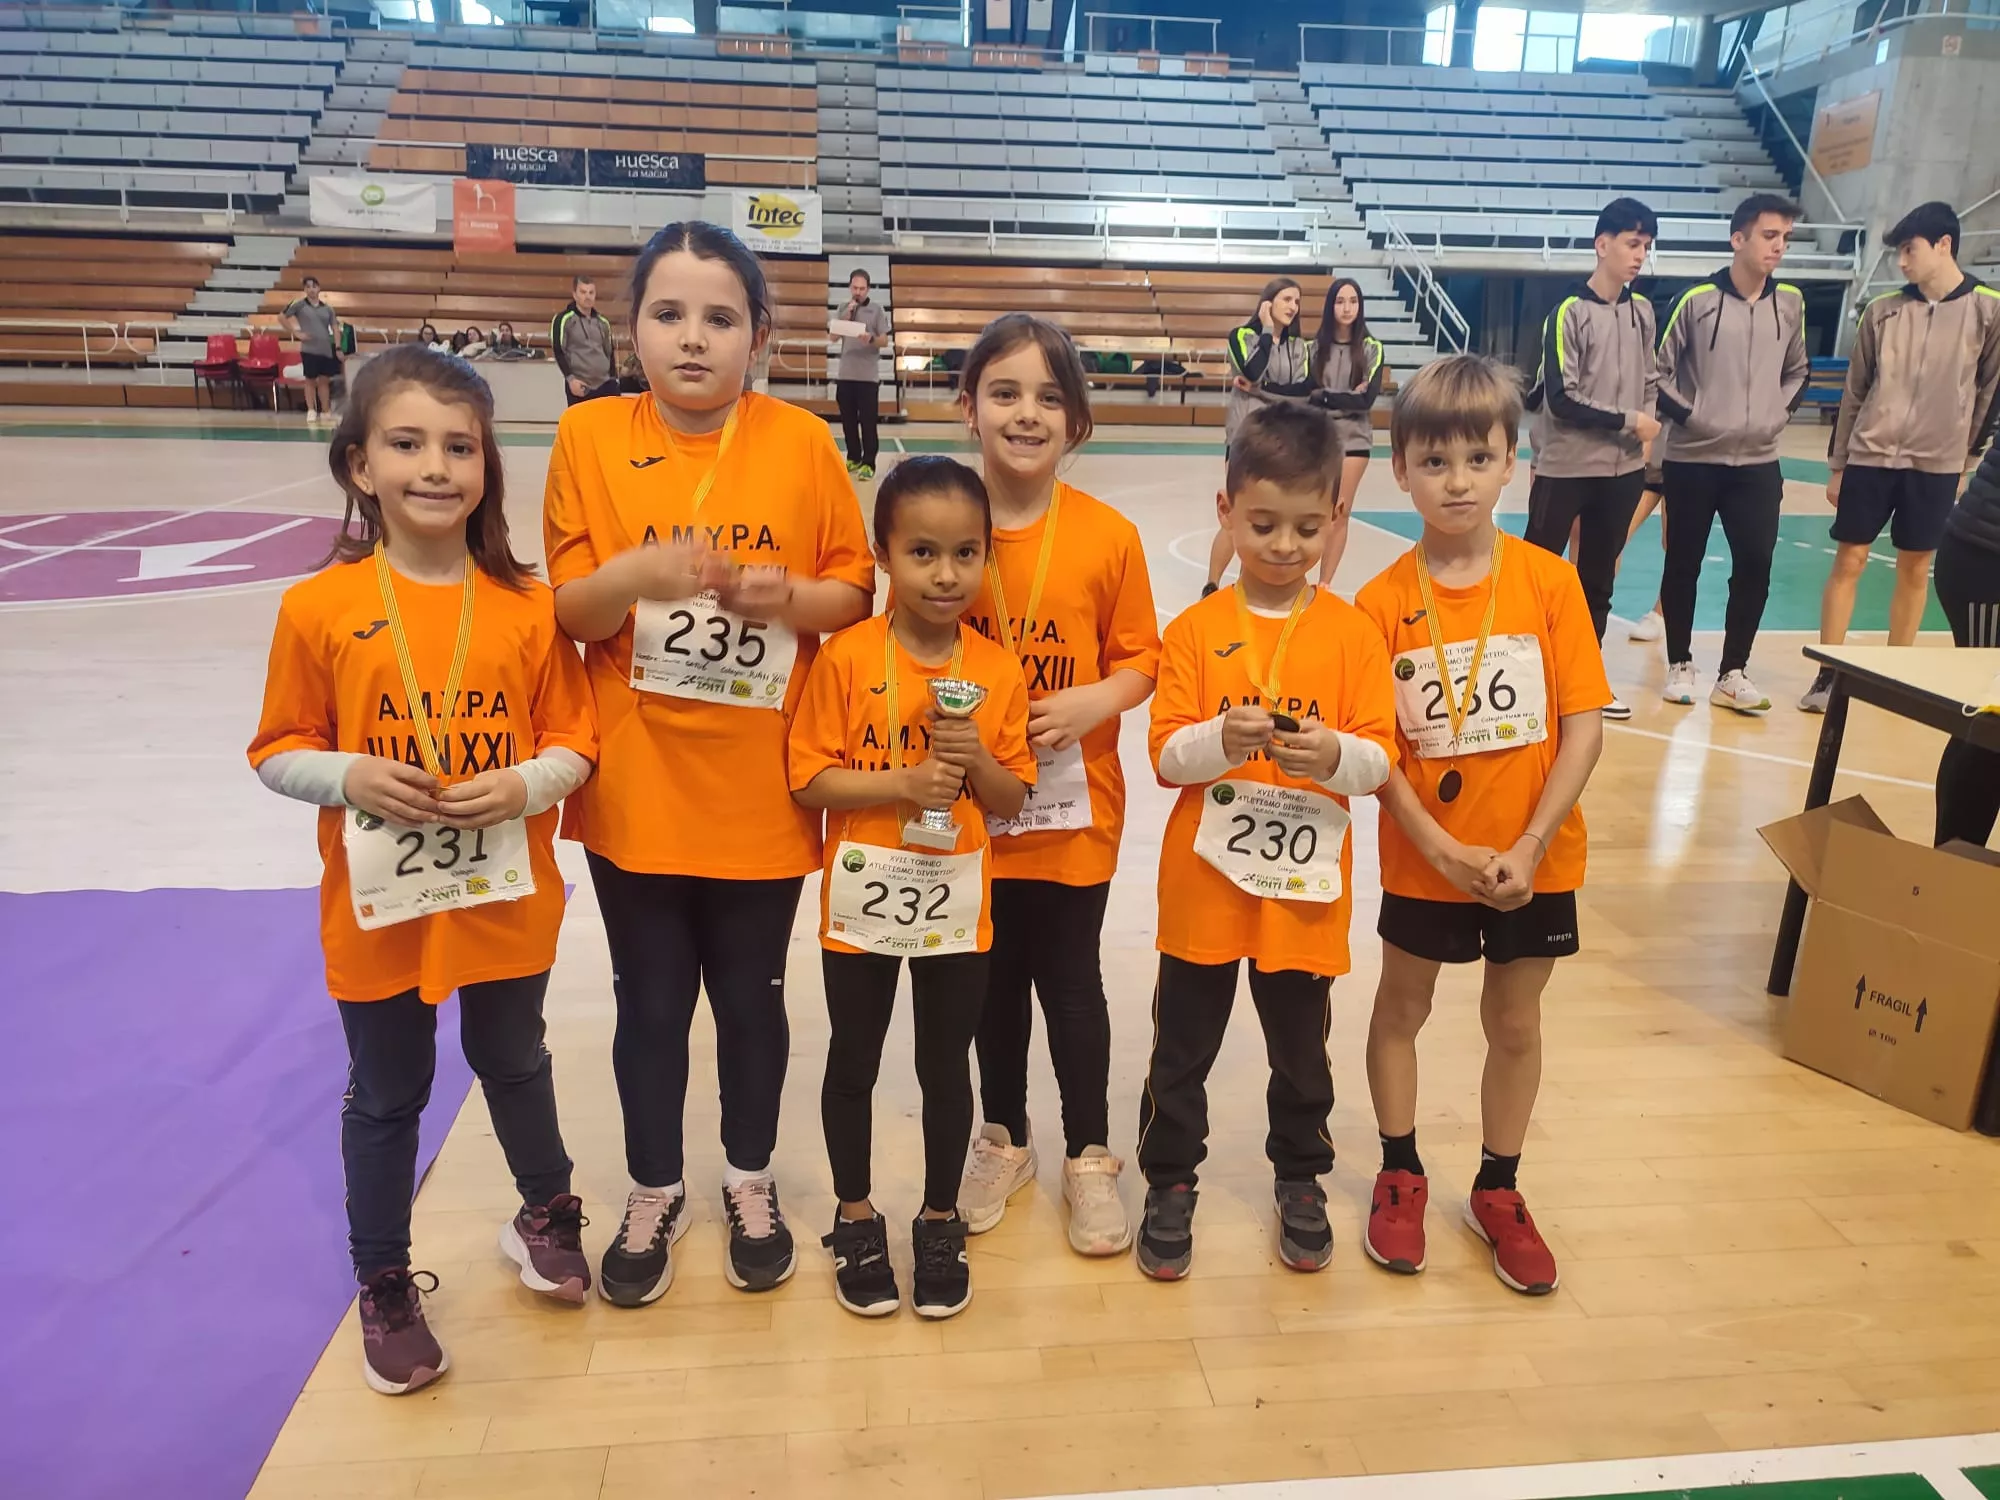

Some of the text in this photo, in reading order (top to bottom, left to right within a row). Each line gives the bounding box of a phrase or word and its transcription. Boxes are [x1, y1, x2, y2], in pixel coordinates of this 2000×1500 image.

[664, 610, 767, 667] 235
[1421, 669, 1516, 720] 236
[396, 825, 487, 878] 231
[1227, 814, 1317, 864] 230
[862, 881, 950, 925] 232
[1912, 886, 1920, 897] 5
[1869, 990, 1912, 1017] FRAGIL
